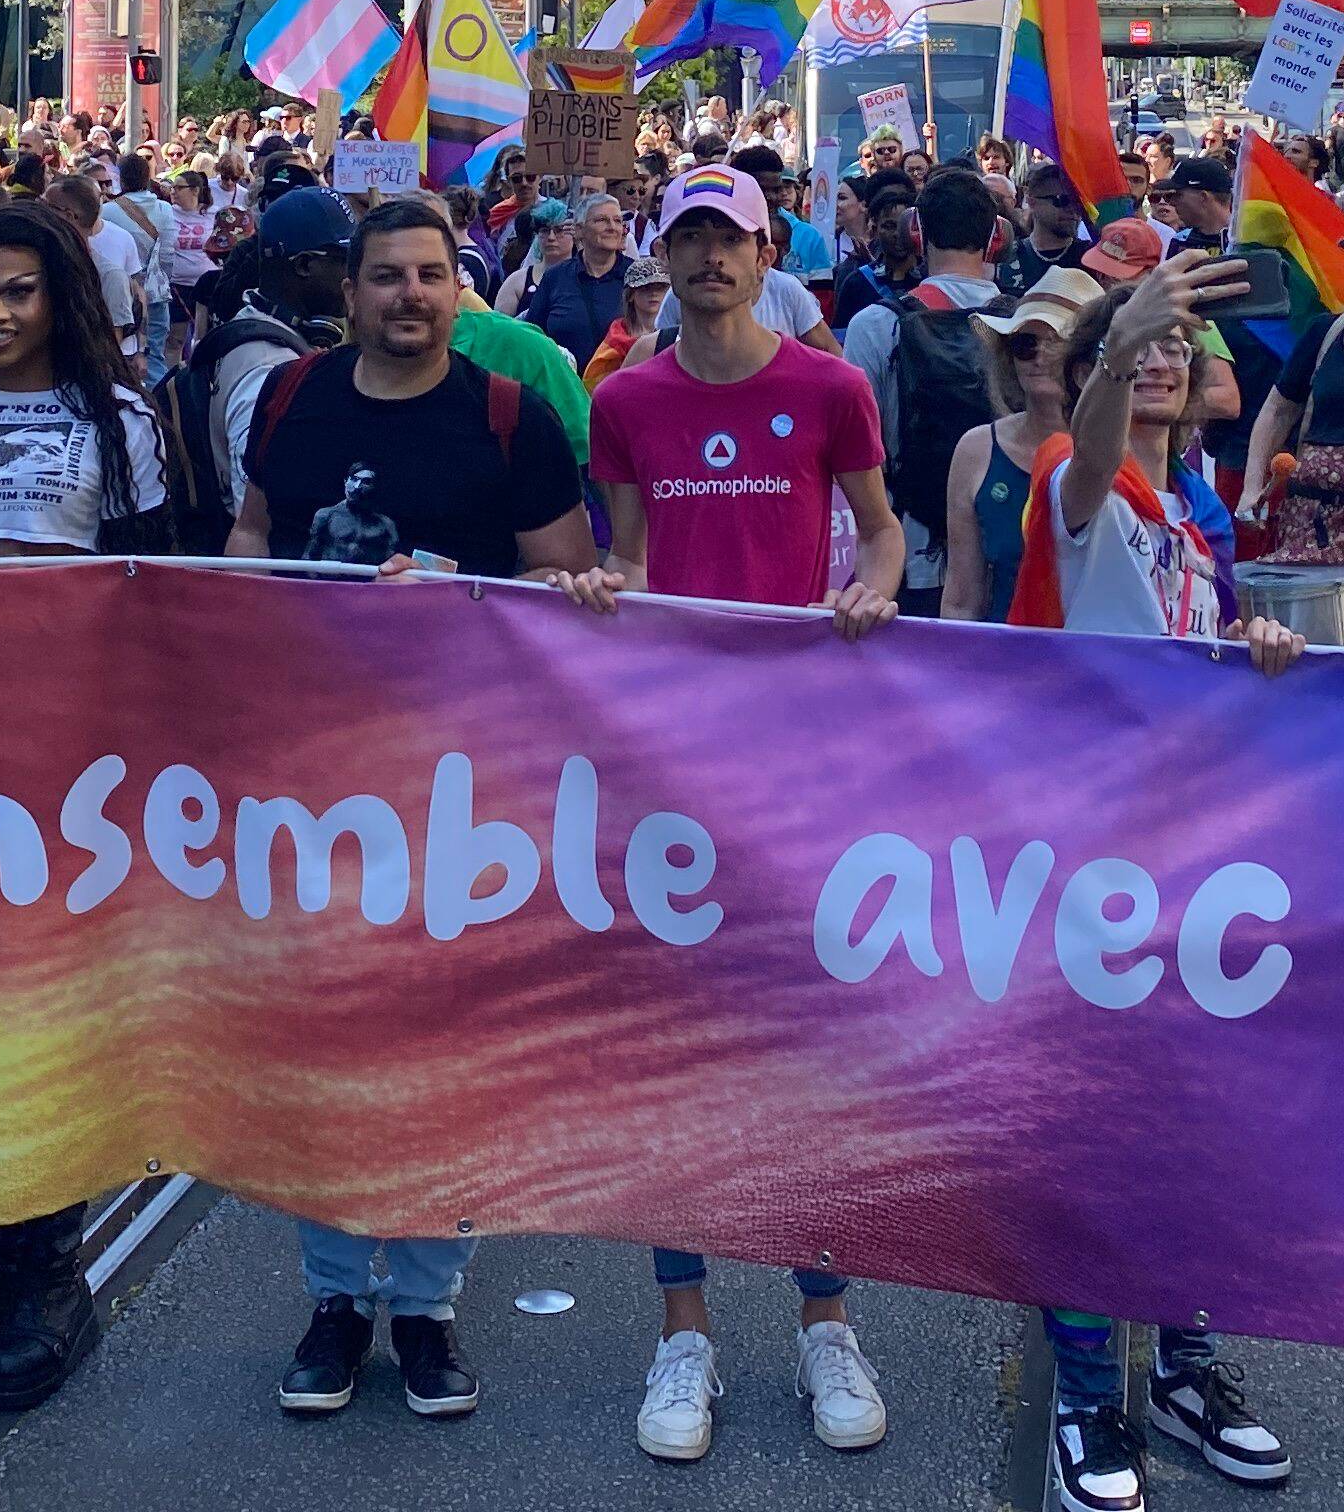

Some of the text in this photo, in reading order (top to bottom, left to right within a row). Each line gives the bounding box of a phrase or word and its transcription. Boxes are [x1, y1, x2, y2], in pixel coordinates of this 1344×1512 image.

[1283, 22, 1333, 49] avec les
[1275, 56, 1316, 79] monde
[1316, 53, 1332, 67] du
[1271, 72, 1308, 93] entier
[531, 92, 552, 109] LA
[864, 89, 905, 108] BORN
[531, 111, 623, 140] PHOBIE
[341, 143, 358, 153] THE
[534, 141, 609, 167] TUE.
[338, 157, 344, 167] I
[353, 157, 376, 167] MADE
[380, 157, 397, 166] WAS
[364, 167, 415, 185] MYSELF
[33, 404, 60, 414] GO
[652, 474, 792, 500] SOShomophobie
[24, 491, 64, 504] SKATE
[813, 832, 1292, 1019] avec
